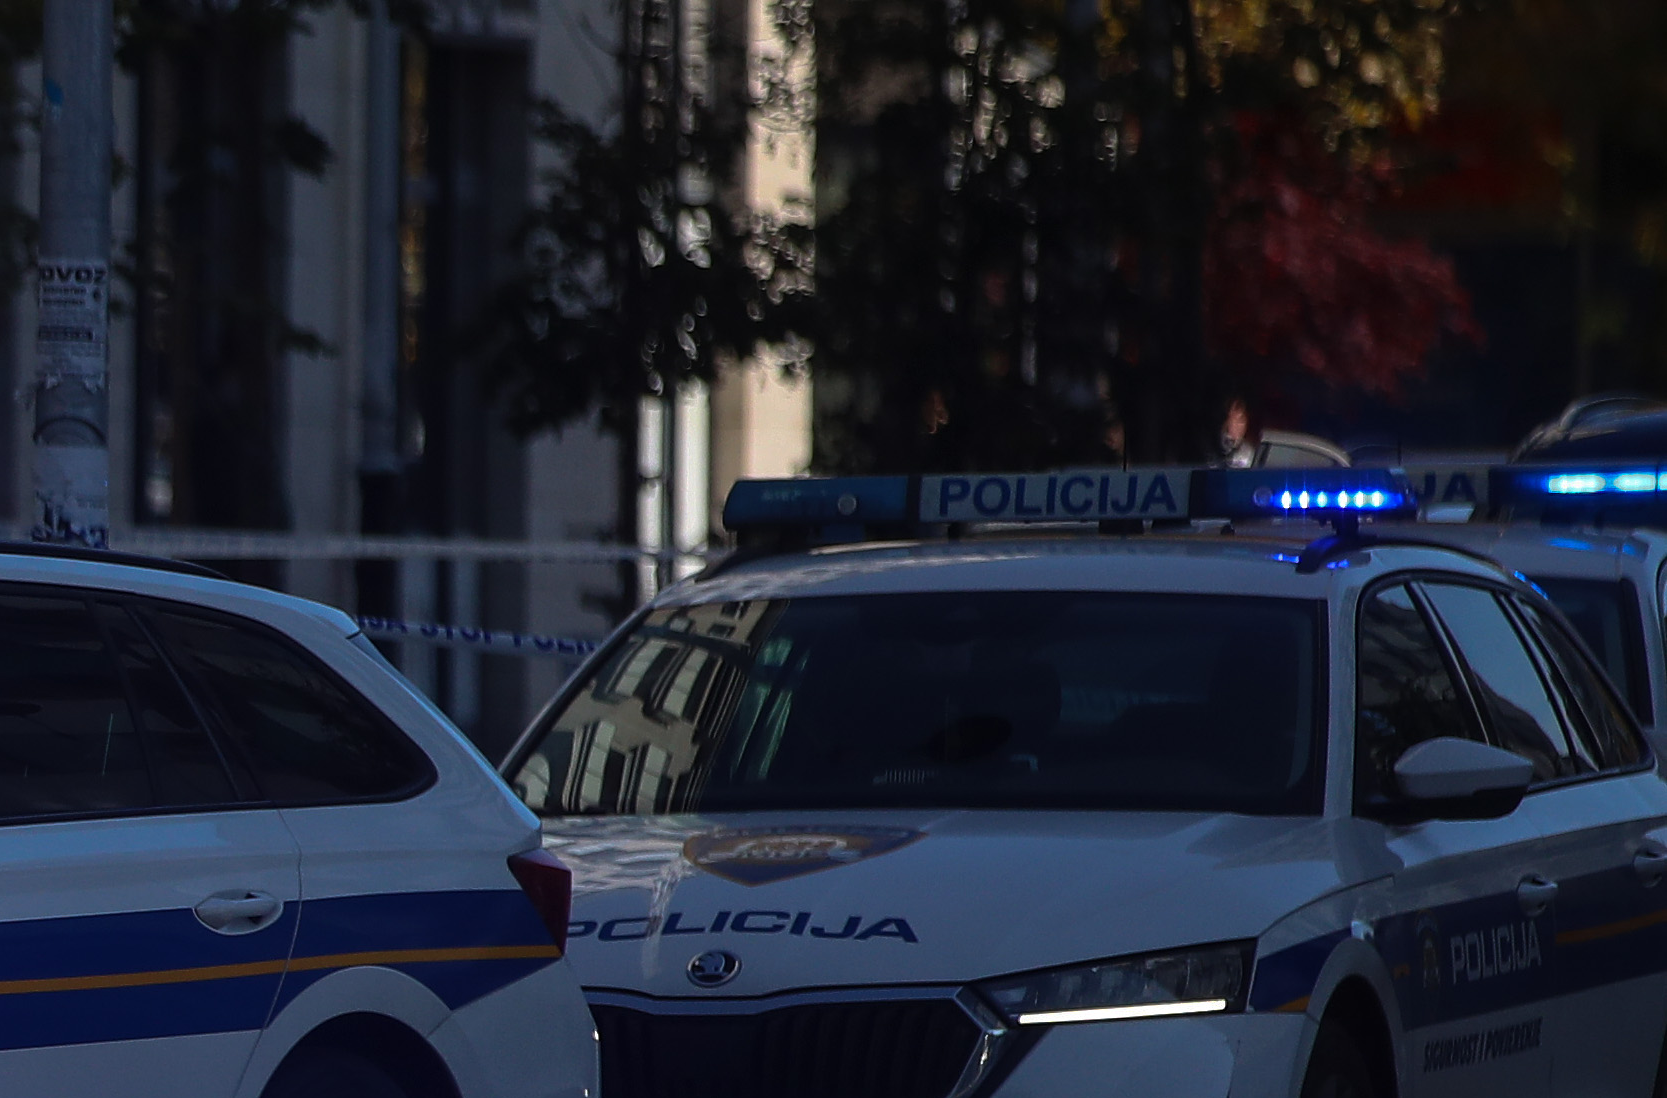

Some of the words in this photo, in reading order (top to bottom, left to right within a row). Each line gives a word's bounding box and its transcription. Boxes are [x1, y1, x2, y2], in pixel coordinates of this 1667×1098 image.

[939, 476, 1177, 516] POLICIJA
[566, 910, 919, 944] POLICIJA
[1450, 921, 1542, 985] POLICIJA
